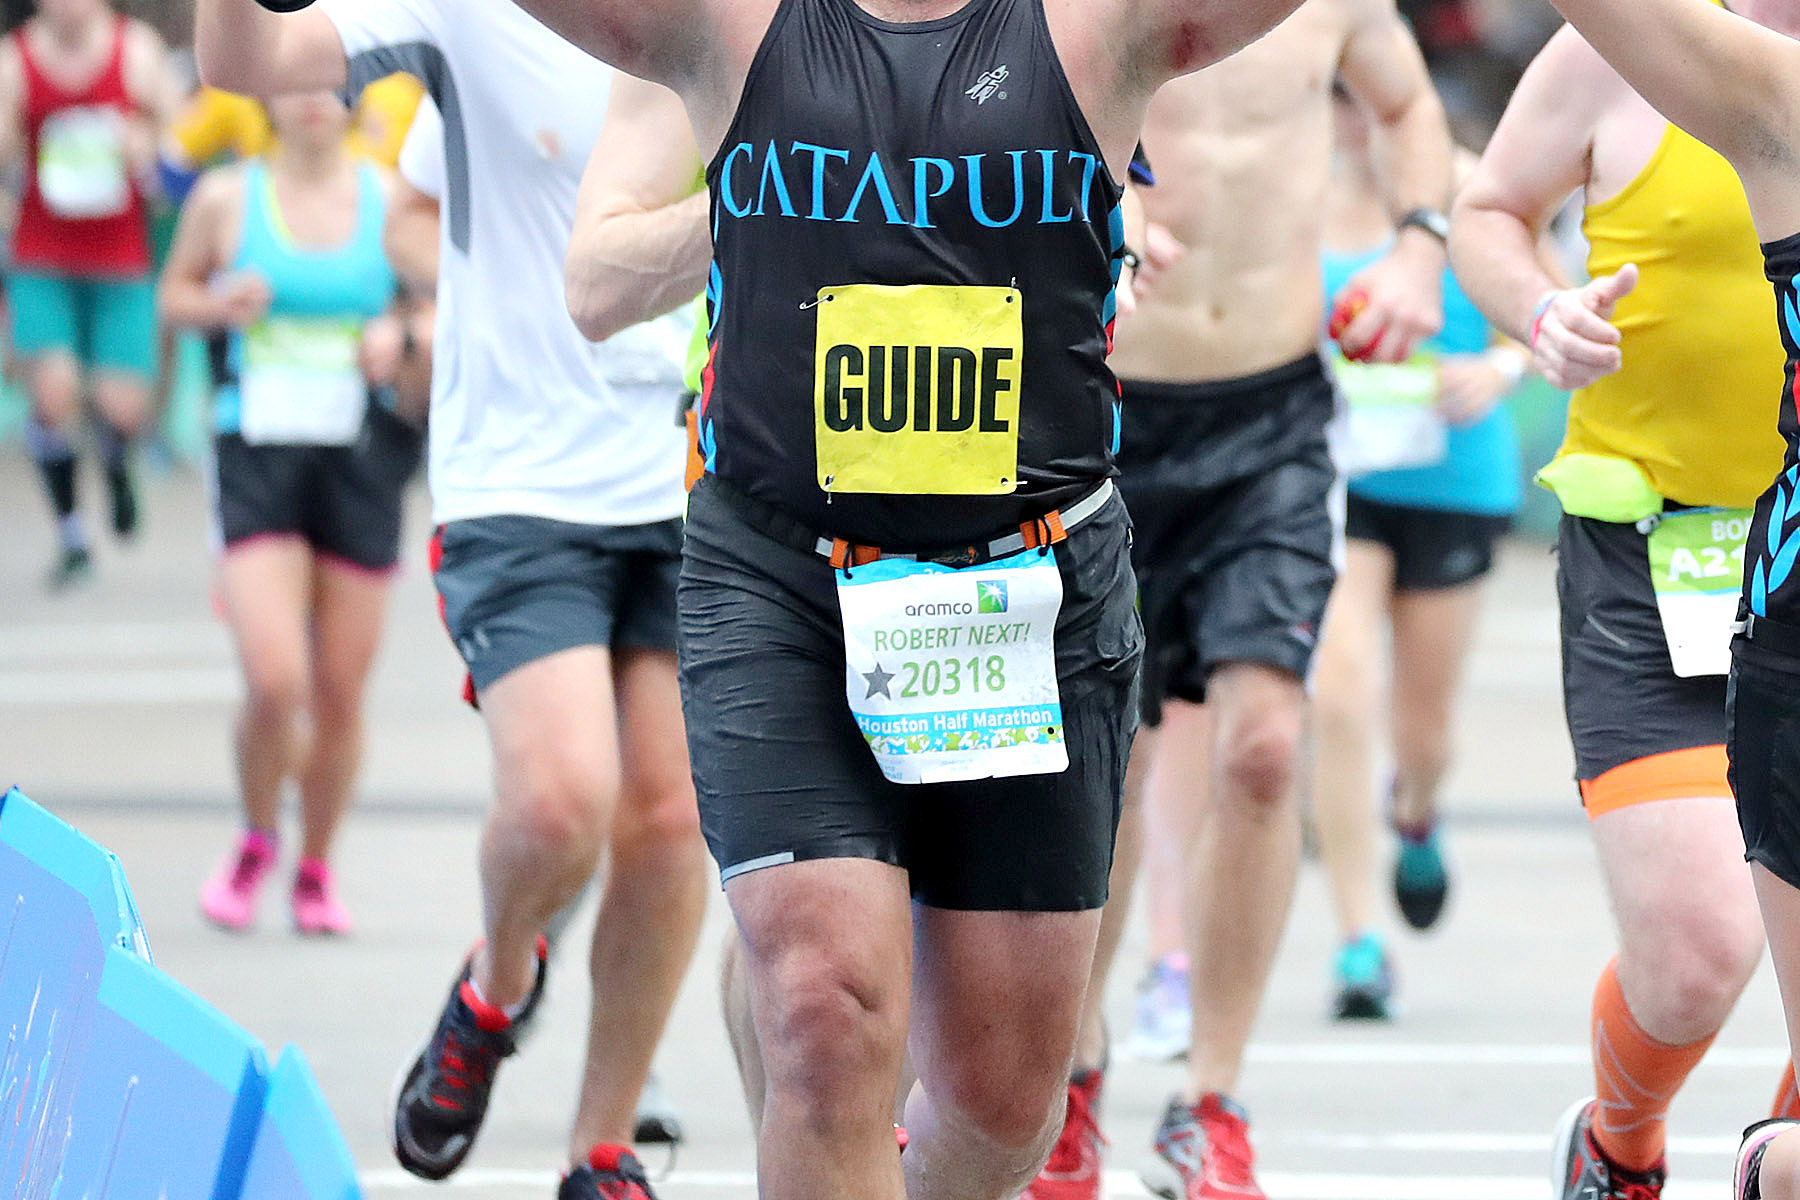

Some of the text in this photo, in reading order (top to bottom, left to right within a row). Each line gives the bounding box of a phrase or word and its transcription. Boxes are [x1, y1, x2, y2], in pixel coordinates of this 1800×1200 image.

[719, 138, 1103, 230] CATAPULT
[823, 343, 1014, 433] GUIDE
[905, 601, 973, 617] aramco
[874, 622, 1031, 652] ROBERT NEXT!
[900, 654, 1006, 698] 20318
[857, 708, 1053, 734] Houston Half Marathon
